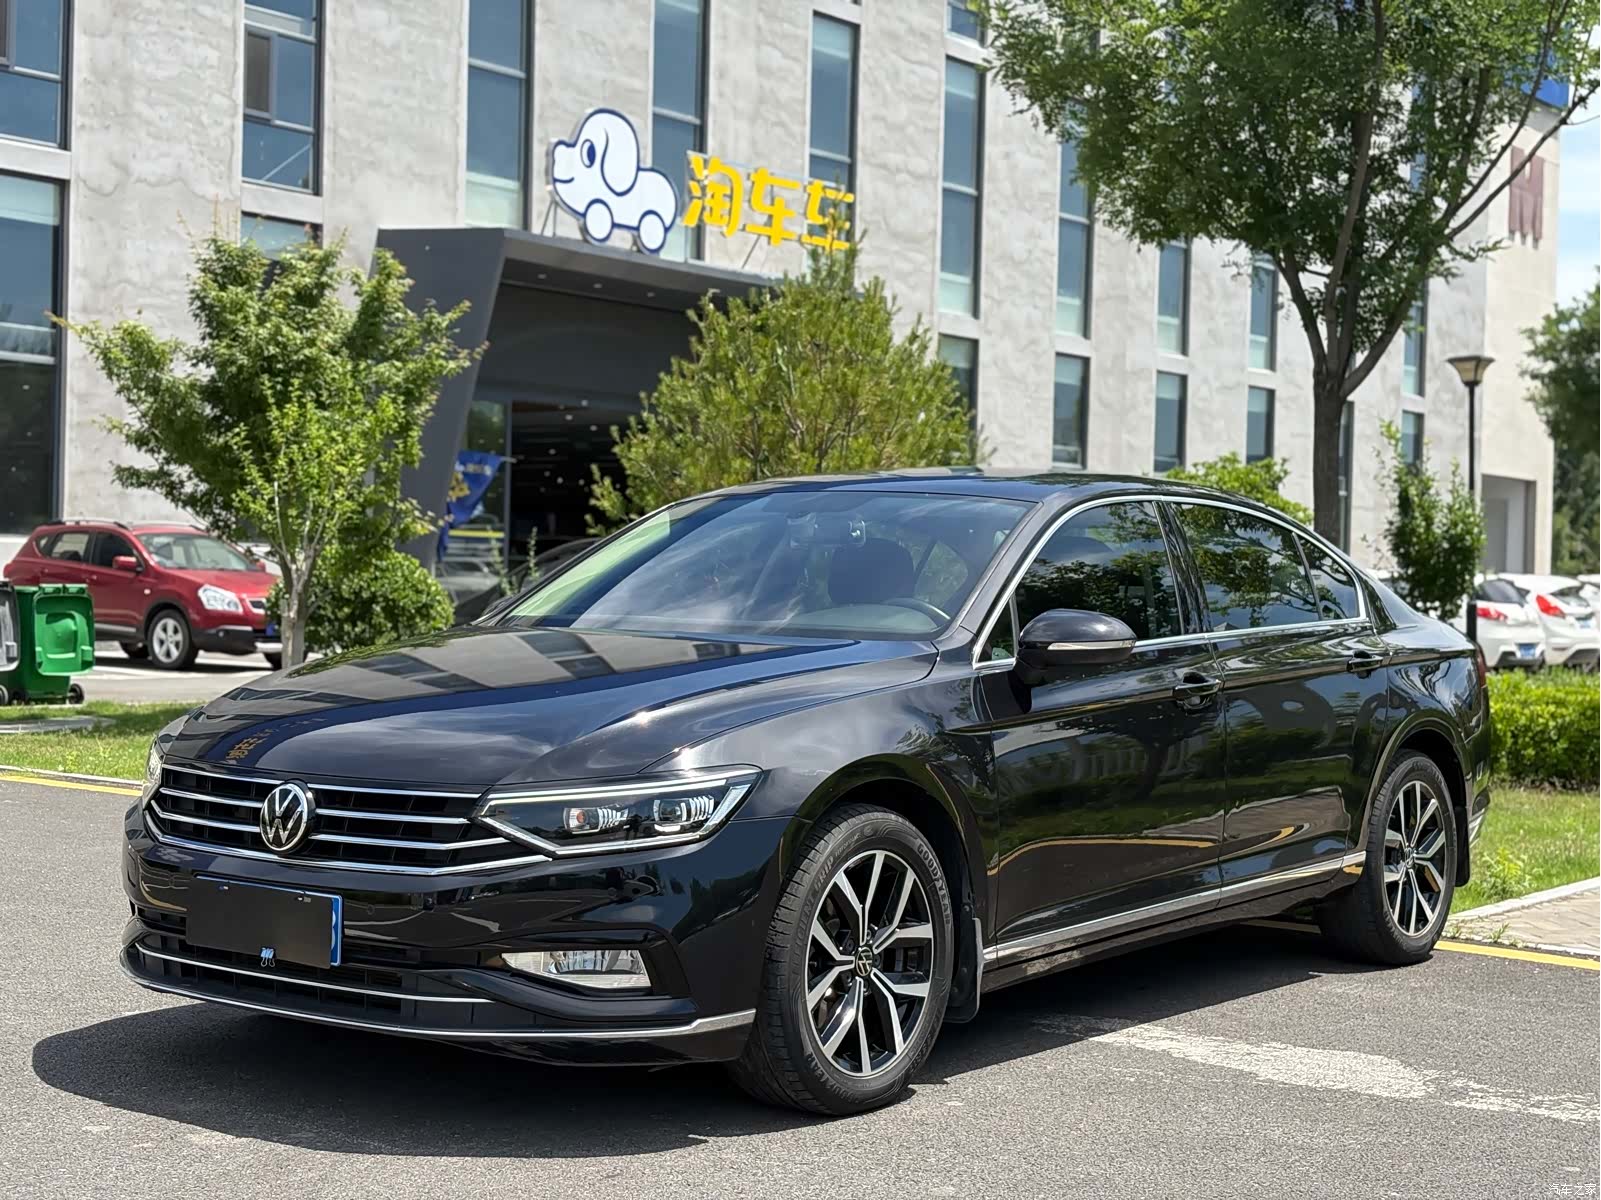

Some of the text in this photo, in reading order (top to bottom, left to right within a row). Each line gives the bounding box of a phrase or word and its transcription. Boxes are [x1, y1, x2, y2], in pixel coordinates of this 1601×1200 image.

[684, 155, 854, 253] 淘车车
[917, 842, 951, 925] GOODYEAR
